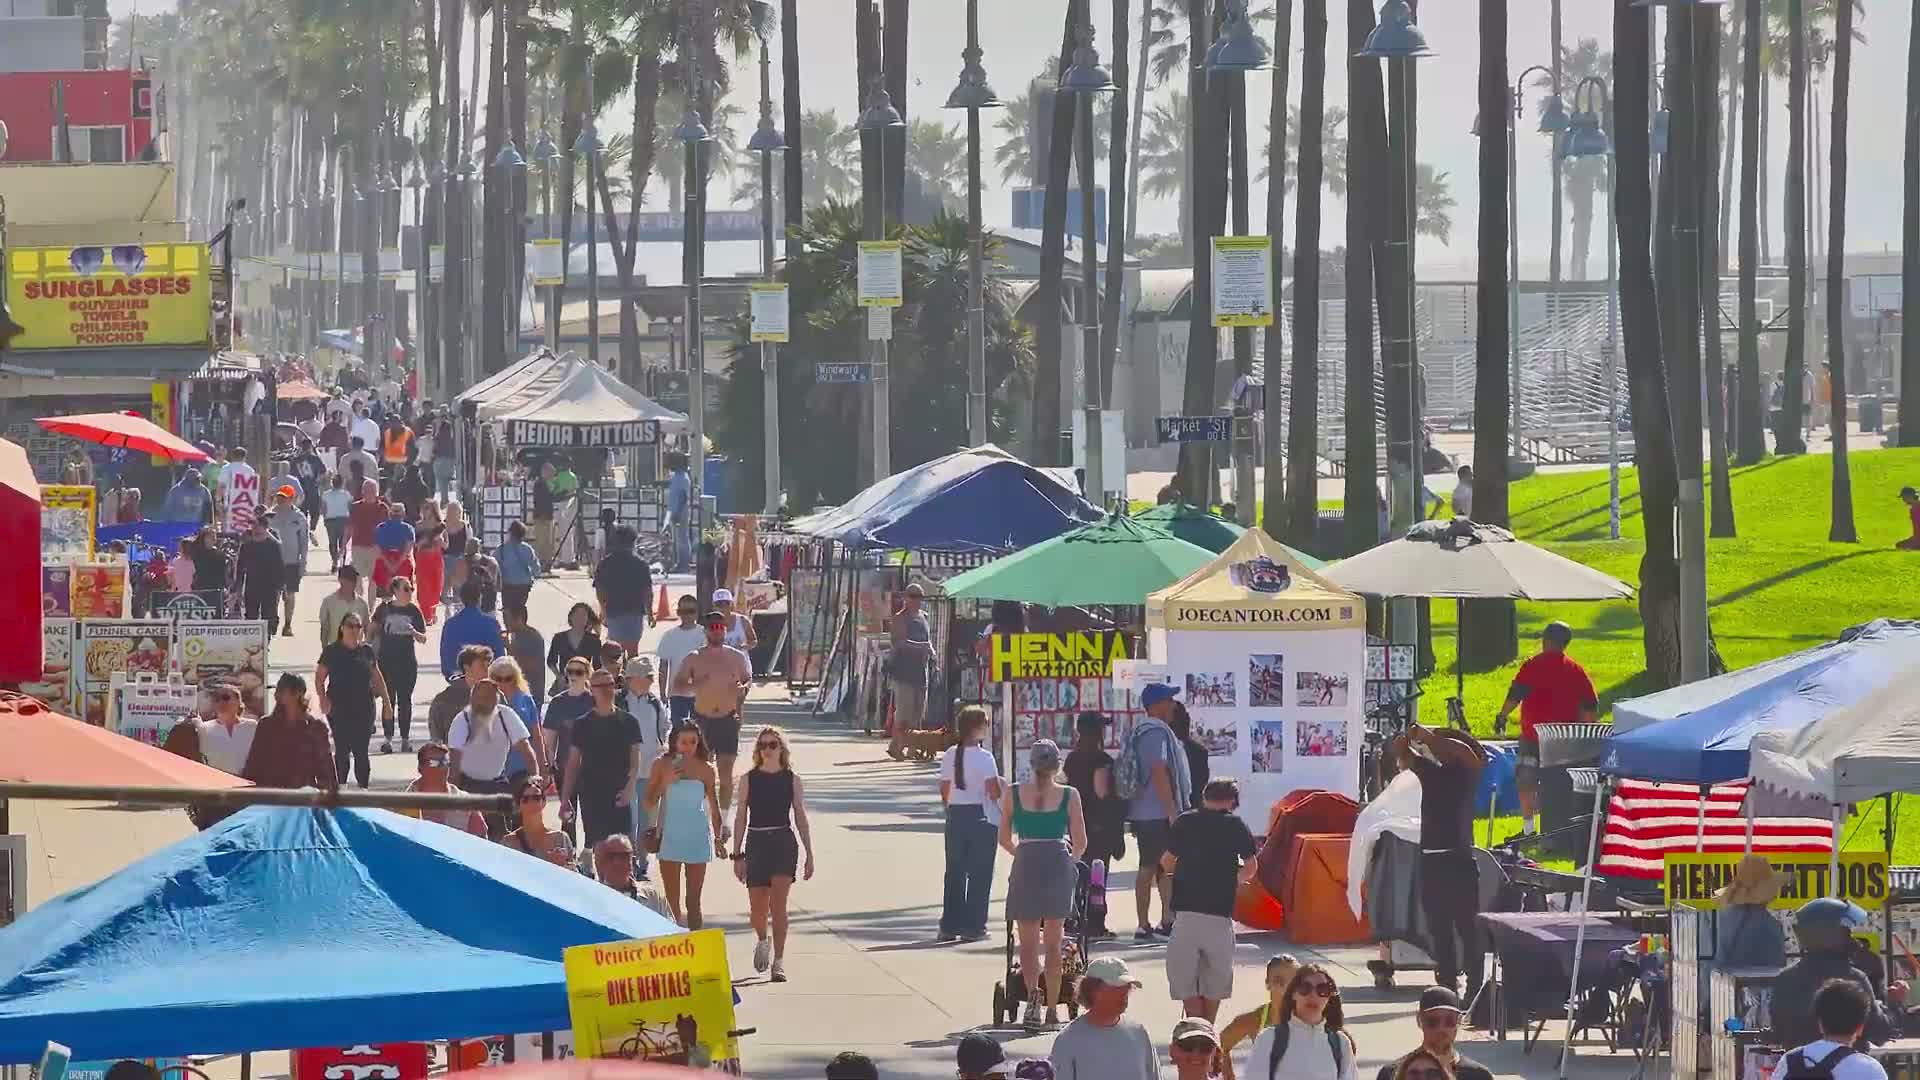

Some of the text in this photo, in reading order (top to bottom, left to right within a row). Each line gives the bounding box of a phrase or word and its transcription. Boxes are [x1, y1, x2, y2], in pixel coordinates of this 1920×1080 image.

[24, 276, 191, 299] SUNGLASSES
[69, 300, 149, 311] SOUVENIRS
[82, 311, 137, 321] TOWELS
[70, 321, 149, 332] CHILDRENS
[76, 332, 144, 344] PONCHOS
[1161, 419, 1227, 432] Market St
[580, 421, 656, 445] TATTOOS
[1177, 607, 1331, 623] JOECANTOR.COM
[88, 627, 167, 635] FUNNEL CAKE
[991, 631, 1128, 683] HENNA
[1669, 863, 1741, 899] HENN
[607, 970, 691, 1006] BIKE RENTALS
